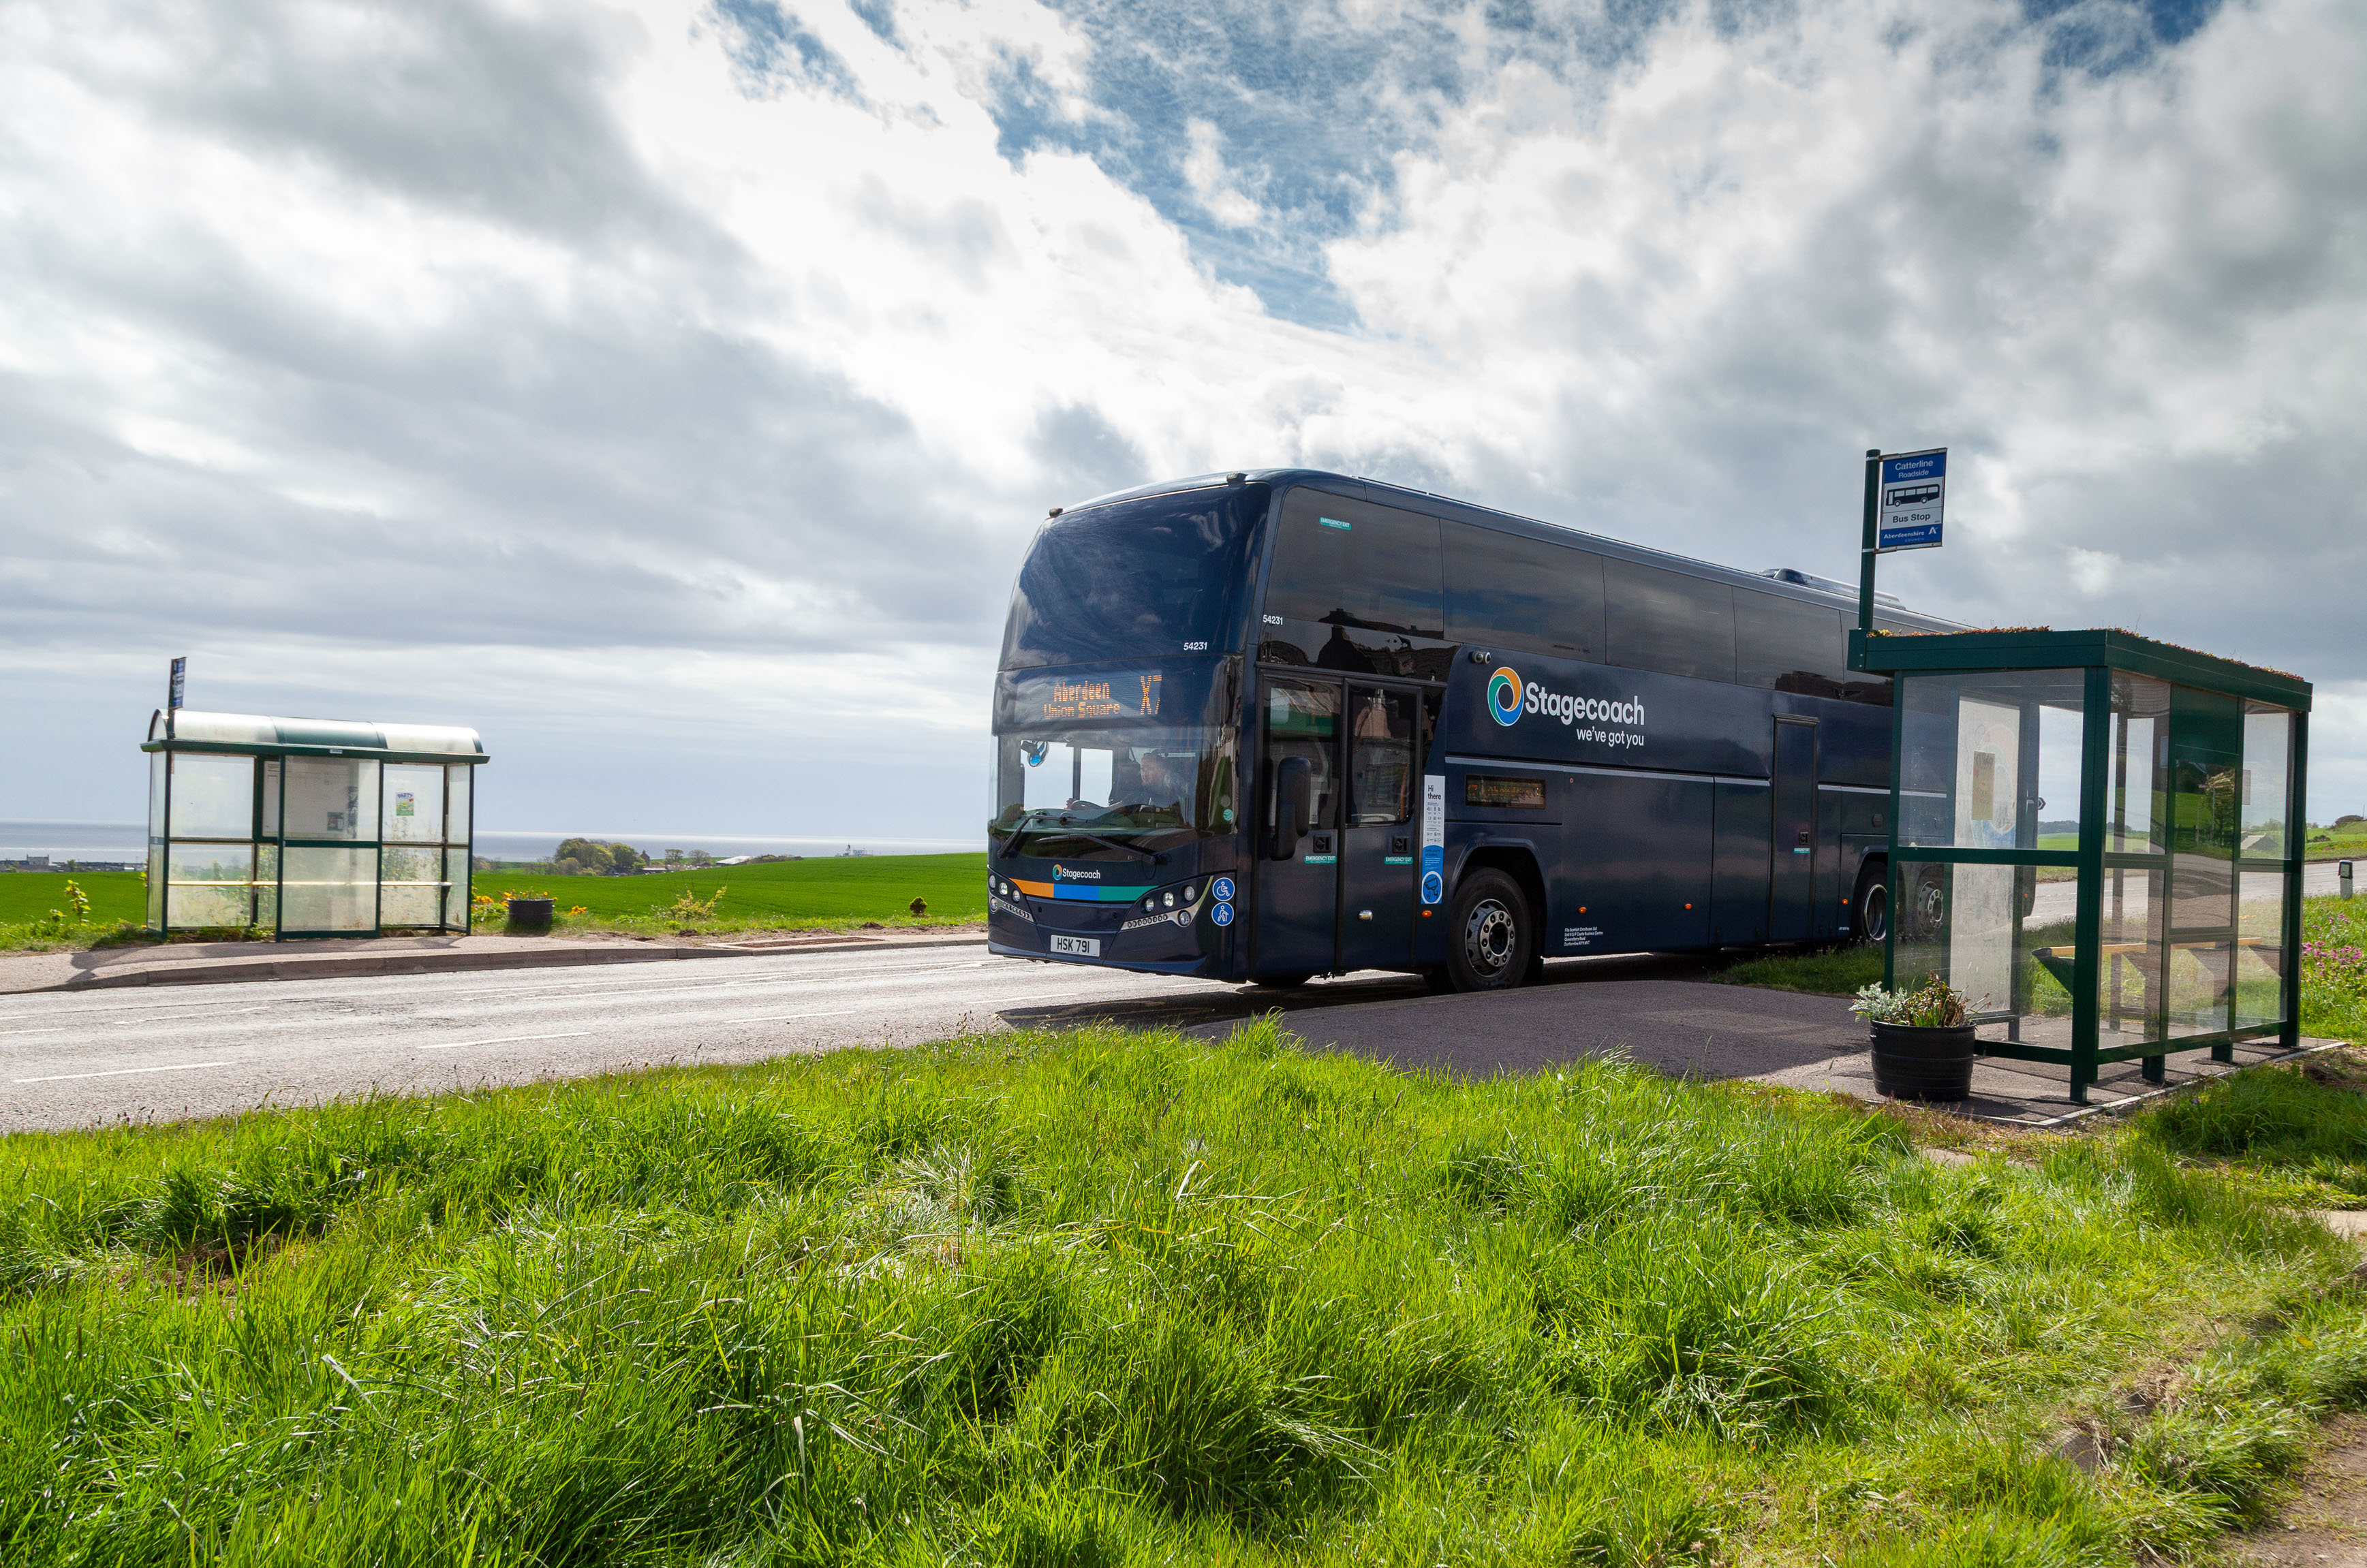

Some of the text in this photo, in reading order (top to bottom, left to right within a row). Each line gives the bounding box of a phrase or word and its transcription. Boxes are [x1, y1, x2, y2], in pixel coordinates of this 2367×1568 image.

[1895, 460, 1934, 471] Catterline
[1898, 469, 1929, 478] Roadside
[1910, 513, 1930, 521] Stop
[1883, 531, 1925, 539] Aberdeenshire
[1263, 614, 1283, 625] 54231
[1183, 642, 1208, 650] 54231
[1054, 680, 1110, 702] Aberdeen
[1525, 682, 1645, 725] Stagecoach
[1044, 702, 1121, 720] Union Square
[1576, 725, 1644, 749] we've got you
[1062, 868, 1101, 880] Stagecoach
[1057, 937, 1090, 954] HSK 791
